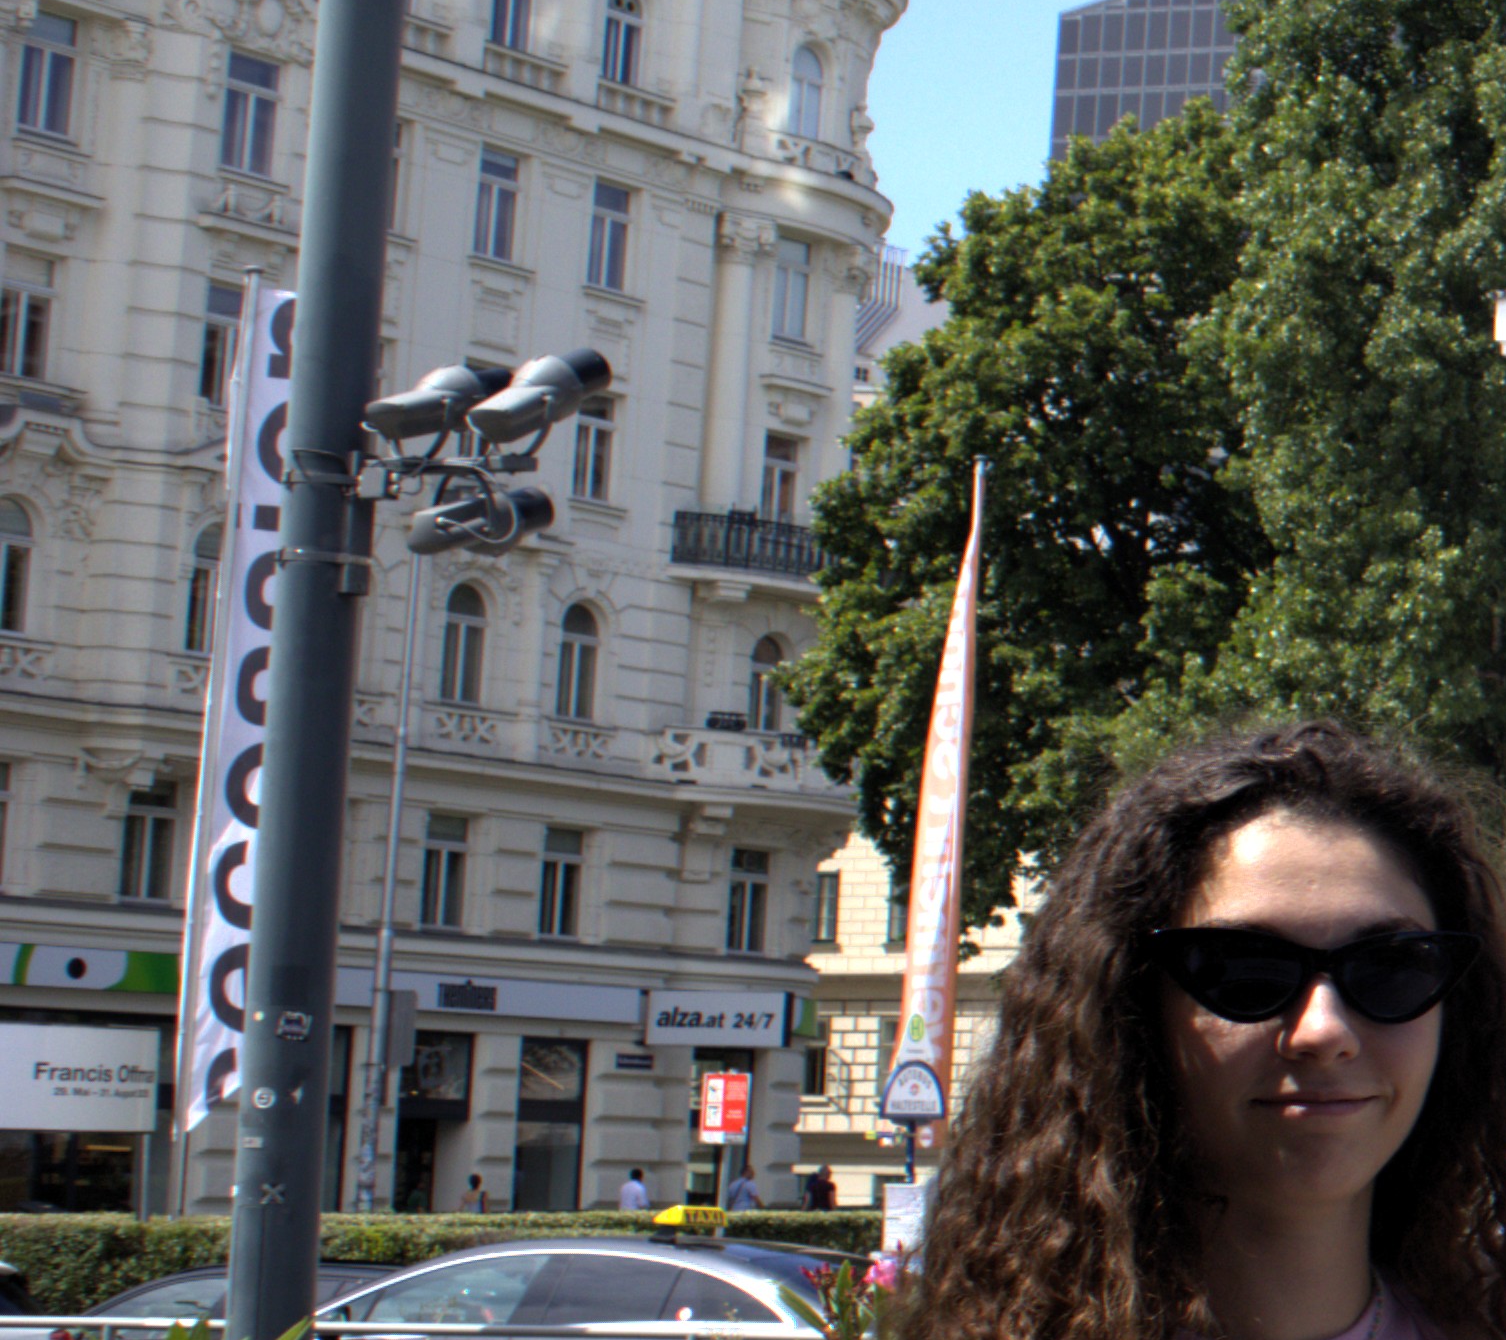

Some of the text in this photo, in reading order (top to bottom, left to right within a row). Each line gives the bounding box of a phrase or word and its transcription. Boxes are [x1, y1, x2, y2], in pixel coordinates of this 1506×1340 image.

[656, 1005, 776, 1030] alza.at 24/7
[33, 1061, 113, 1082] Francis
[685, 1209, 725, 1226] TAXI
